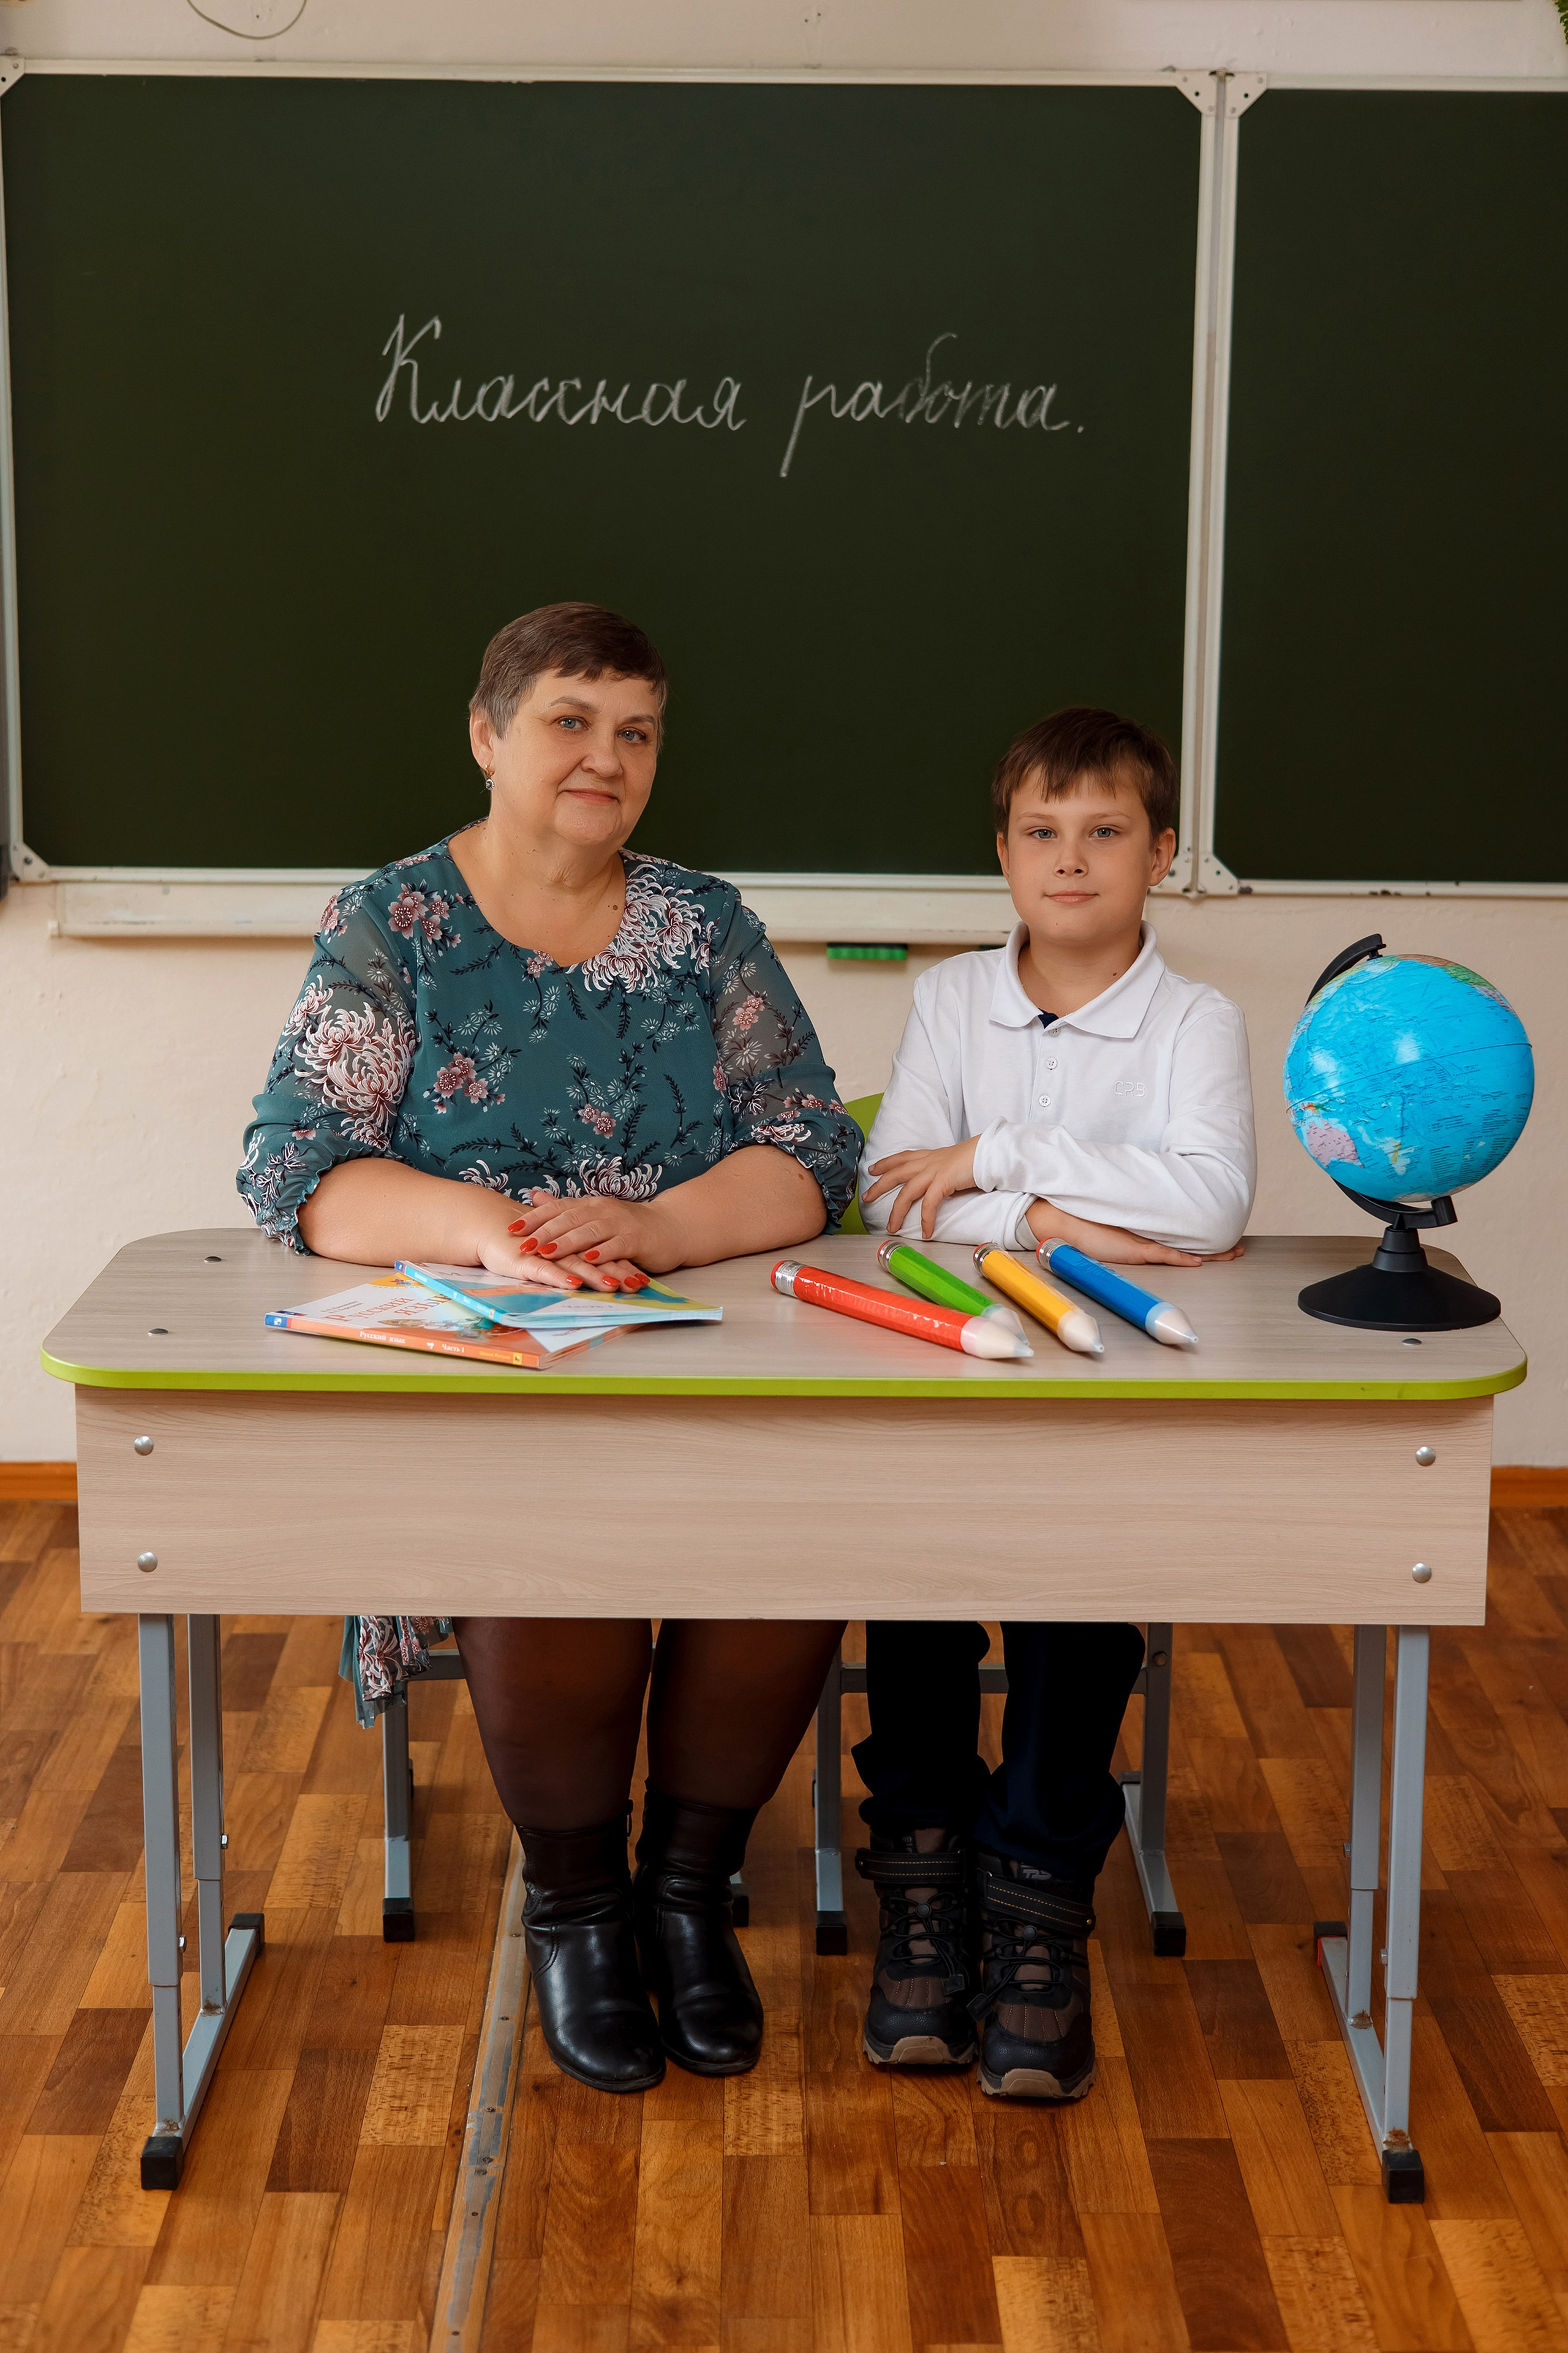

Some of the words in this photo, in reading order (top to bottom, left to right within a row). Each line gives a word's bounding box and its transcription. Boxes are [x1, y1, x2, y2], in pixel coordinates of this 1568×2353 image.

[375, 313, 748, 431] Классная
[779, 332, 1084, 477] работа.
[359, 1331, 386, 1340] Русский
[388, 1335, 406, 1344] язык
[441, 1343, 461, 1353] Часть
